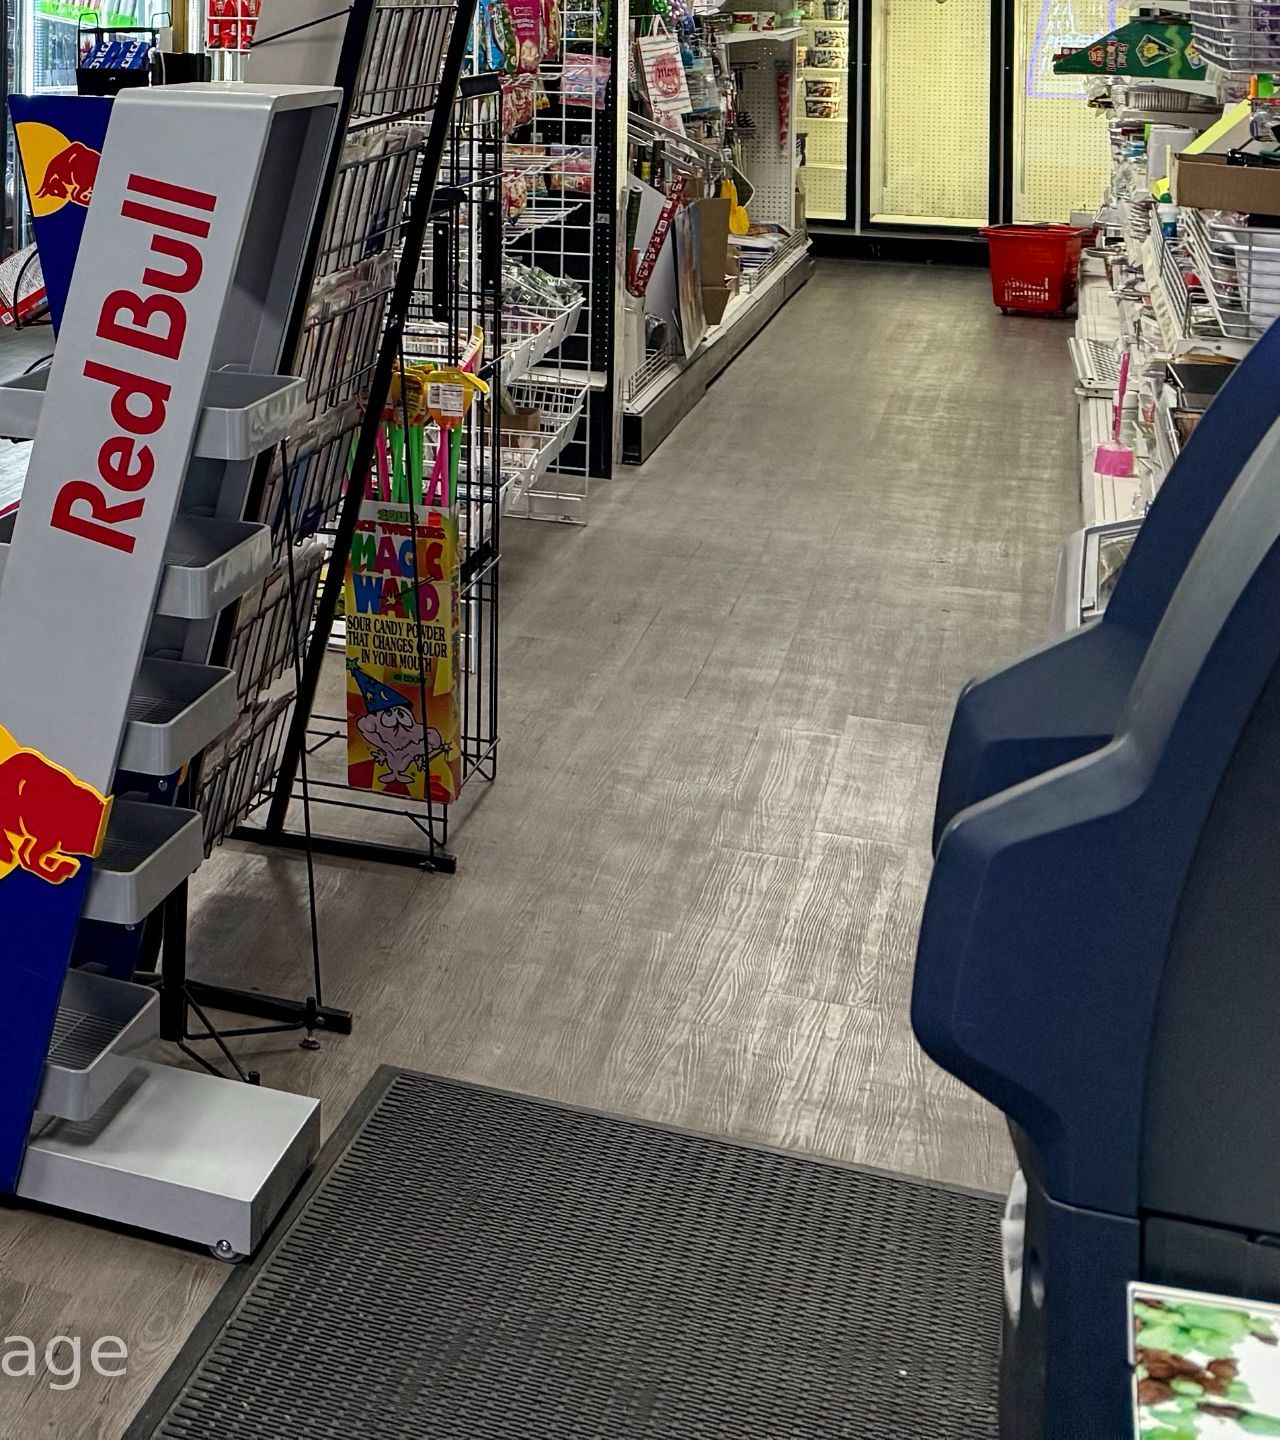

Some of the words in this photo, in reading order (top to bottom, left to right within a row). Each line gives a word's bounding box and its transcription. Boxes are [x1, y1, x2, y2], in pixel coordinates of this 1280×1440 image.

[95, 173, 218, 361] Bull
[49, 359, 172, 555] Red
[350, 532, 444, 581] MAGIC
[352, 572, 440, 623] WAND
[347, 615, 372, 633] SOUR
[373, 618, 405, 638] CANDY
[347, 631, 370, 648] THAT
[372, 634, 414, 654] CHANGES
[361, 648, 371, 663] IN
[372, 650, 398, 669] YOUR
